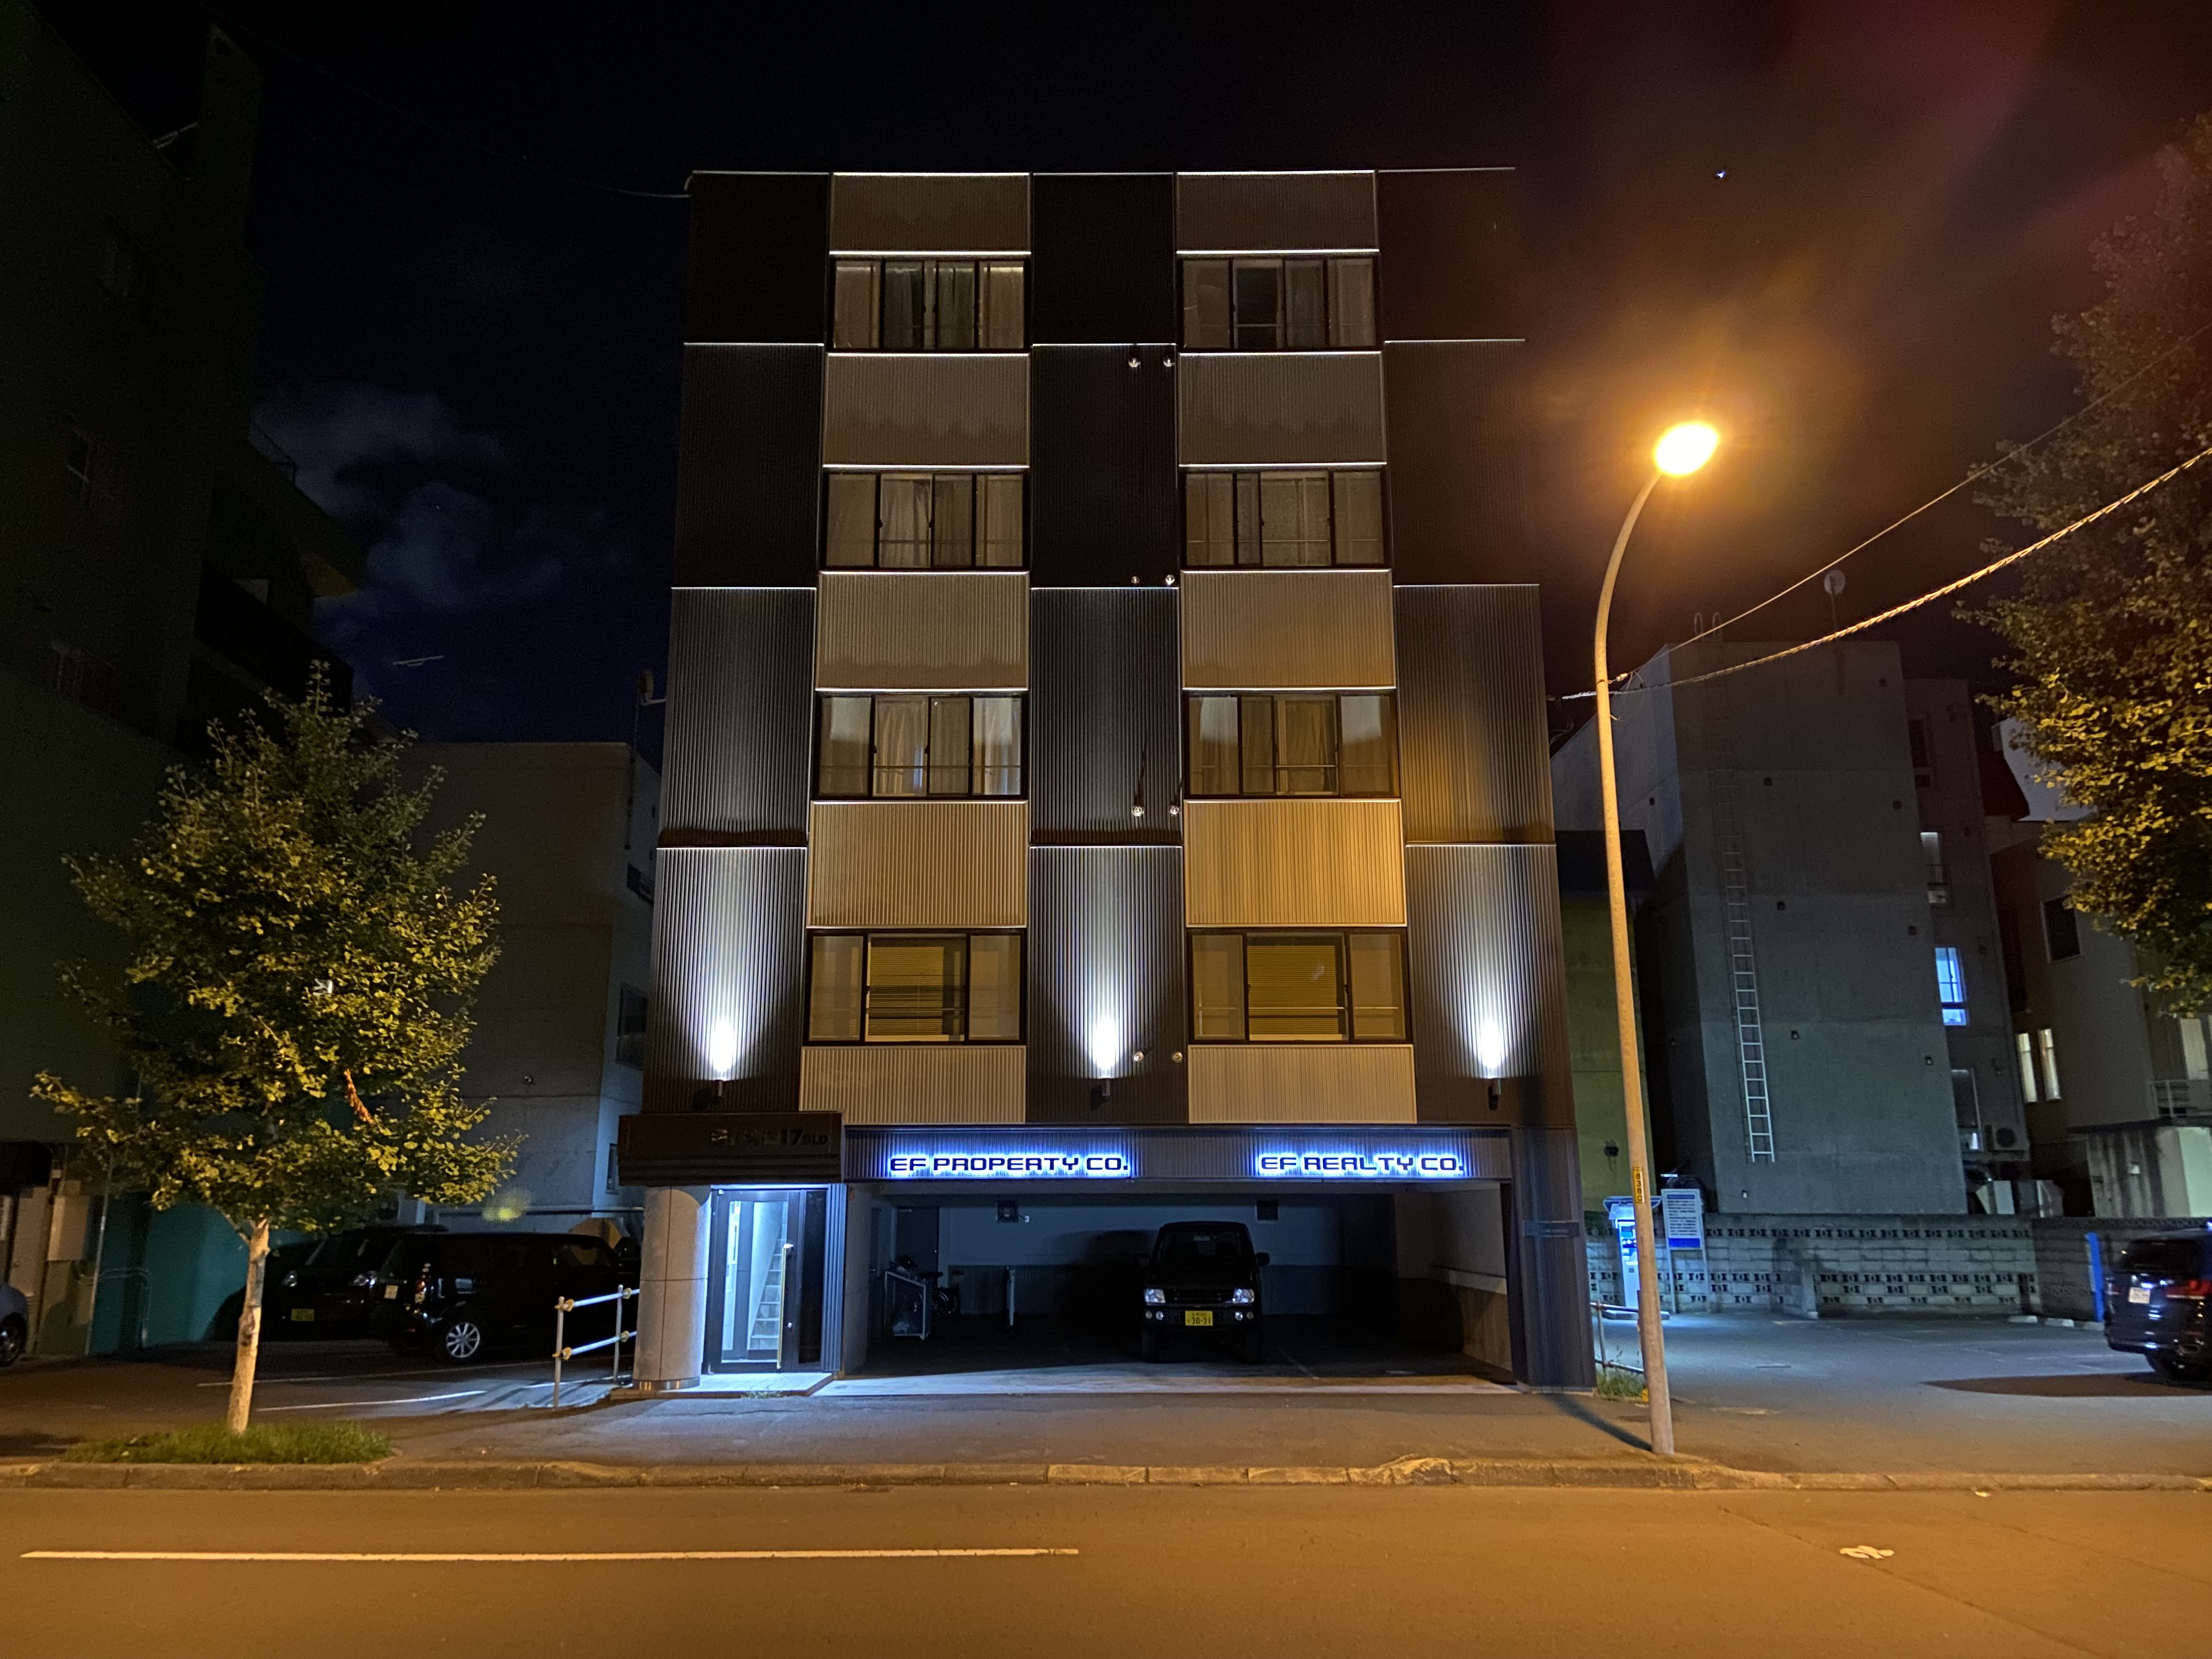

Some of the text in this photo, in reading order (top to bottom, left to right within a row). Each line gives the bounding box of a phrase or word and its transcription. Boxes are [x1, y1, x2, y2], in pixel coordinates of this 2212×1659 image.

[889, 1157, 1129, 1171] EF PROPERTY CO.
[1261, 1156, 1465, 1171] EF REALTY CO.
